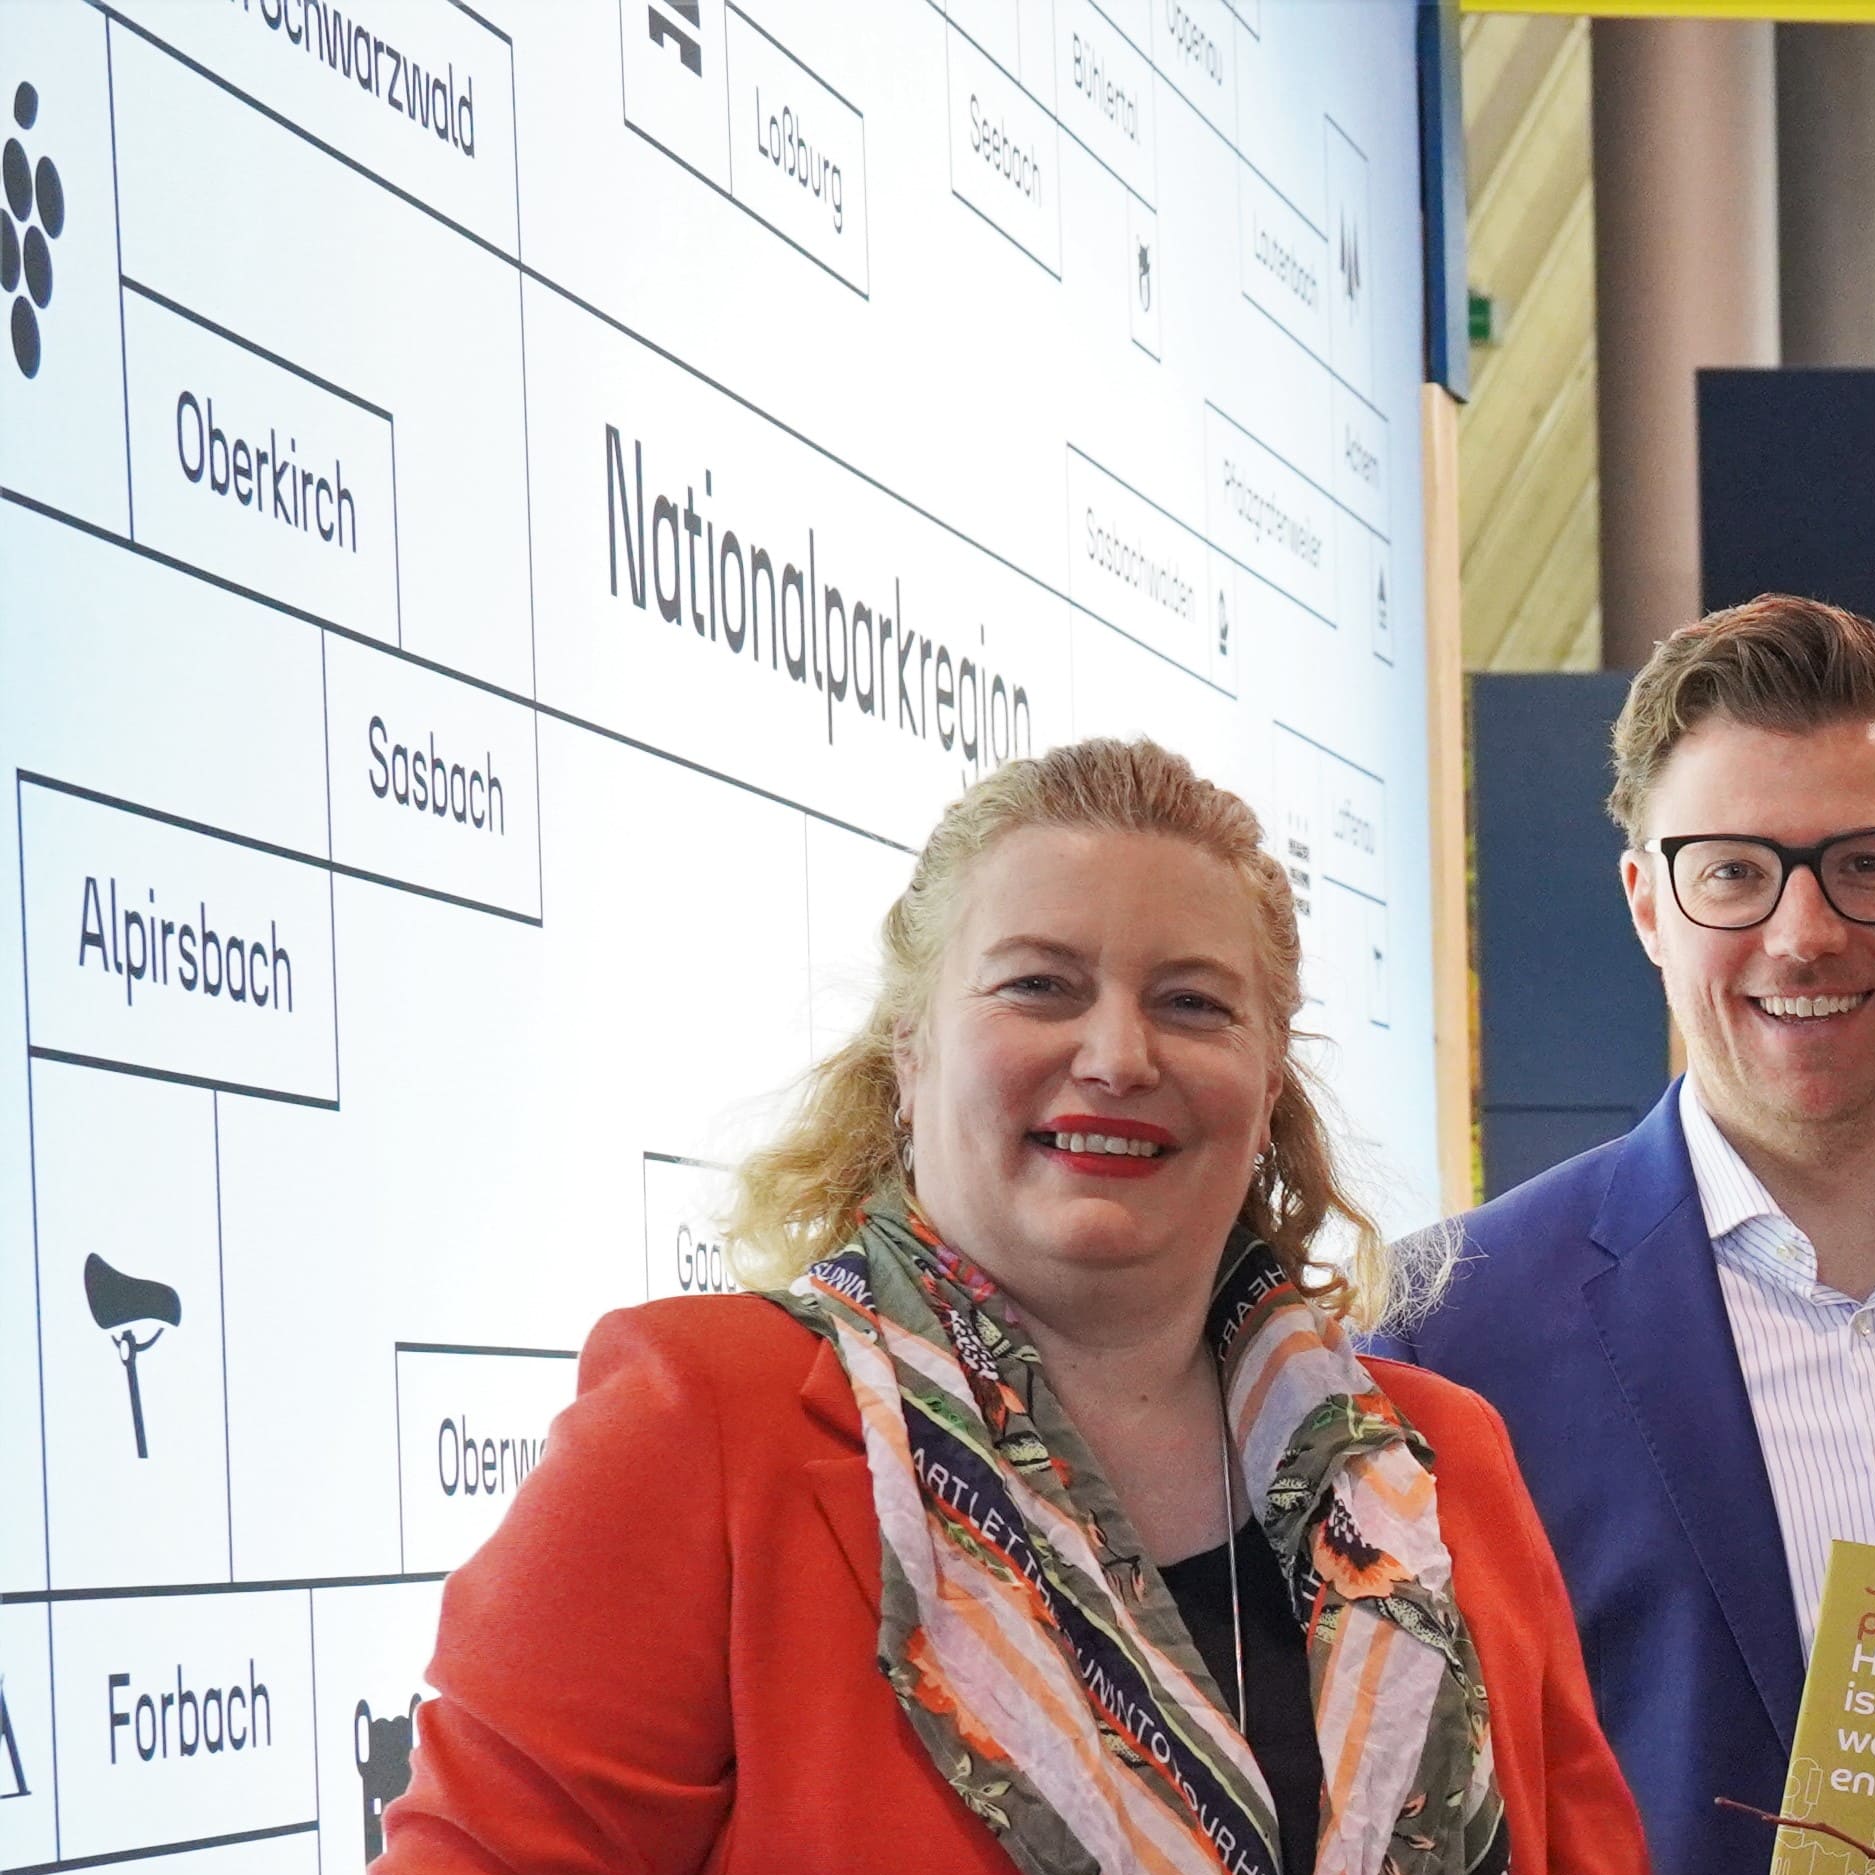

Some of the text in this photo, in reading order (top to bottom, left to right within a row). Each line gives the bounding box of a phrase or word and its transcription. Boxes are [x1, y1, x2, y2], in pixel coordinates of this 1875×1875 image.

[756, 86, 843, 234] Loßburg
[970, 94, 1041, 208] Seebach
[177, 391, 358, 553] Oberkirch
[605, 423, 1031, 792] Nationalparkregion
[368, 715, 505, 835] Sasbach
[79, 876, 293, 1013] Alpirsbach
[438, 1414, 546, 1496] Oberw
[108, 1658, 272, 1765] Forbach
